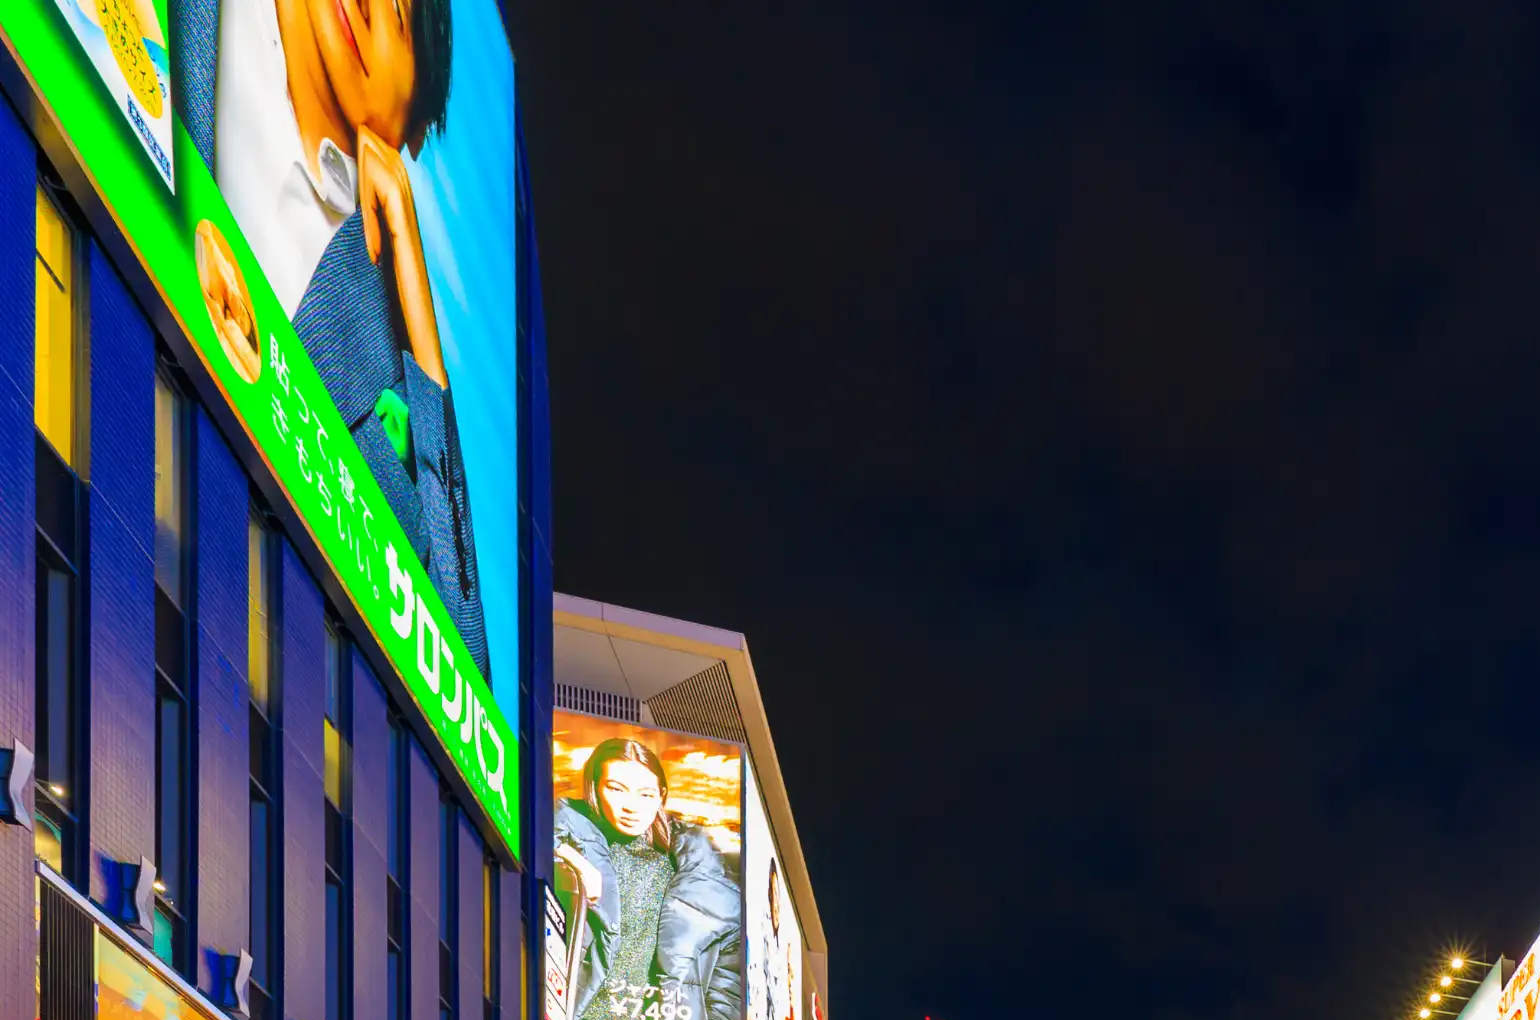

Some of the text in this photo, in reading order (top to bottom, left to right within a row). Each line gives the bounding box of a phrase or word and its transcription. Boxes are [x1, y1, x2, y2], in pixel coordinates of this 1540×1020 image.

[385, 541, 509, 818] サロンパス
[608, 978, 688, 1003] ジャケット
